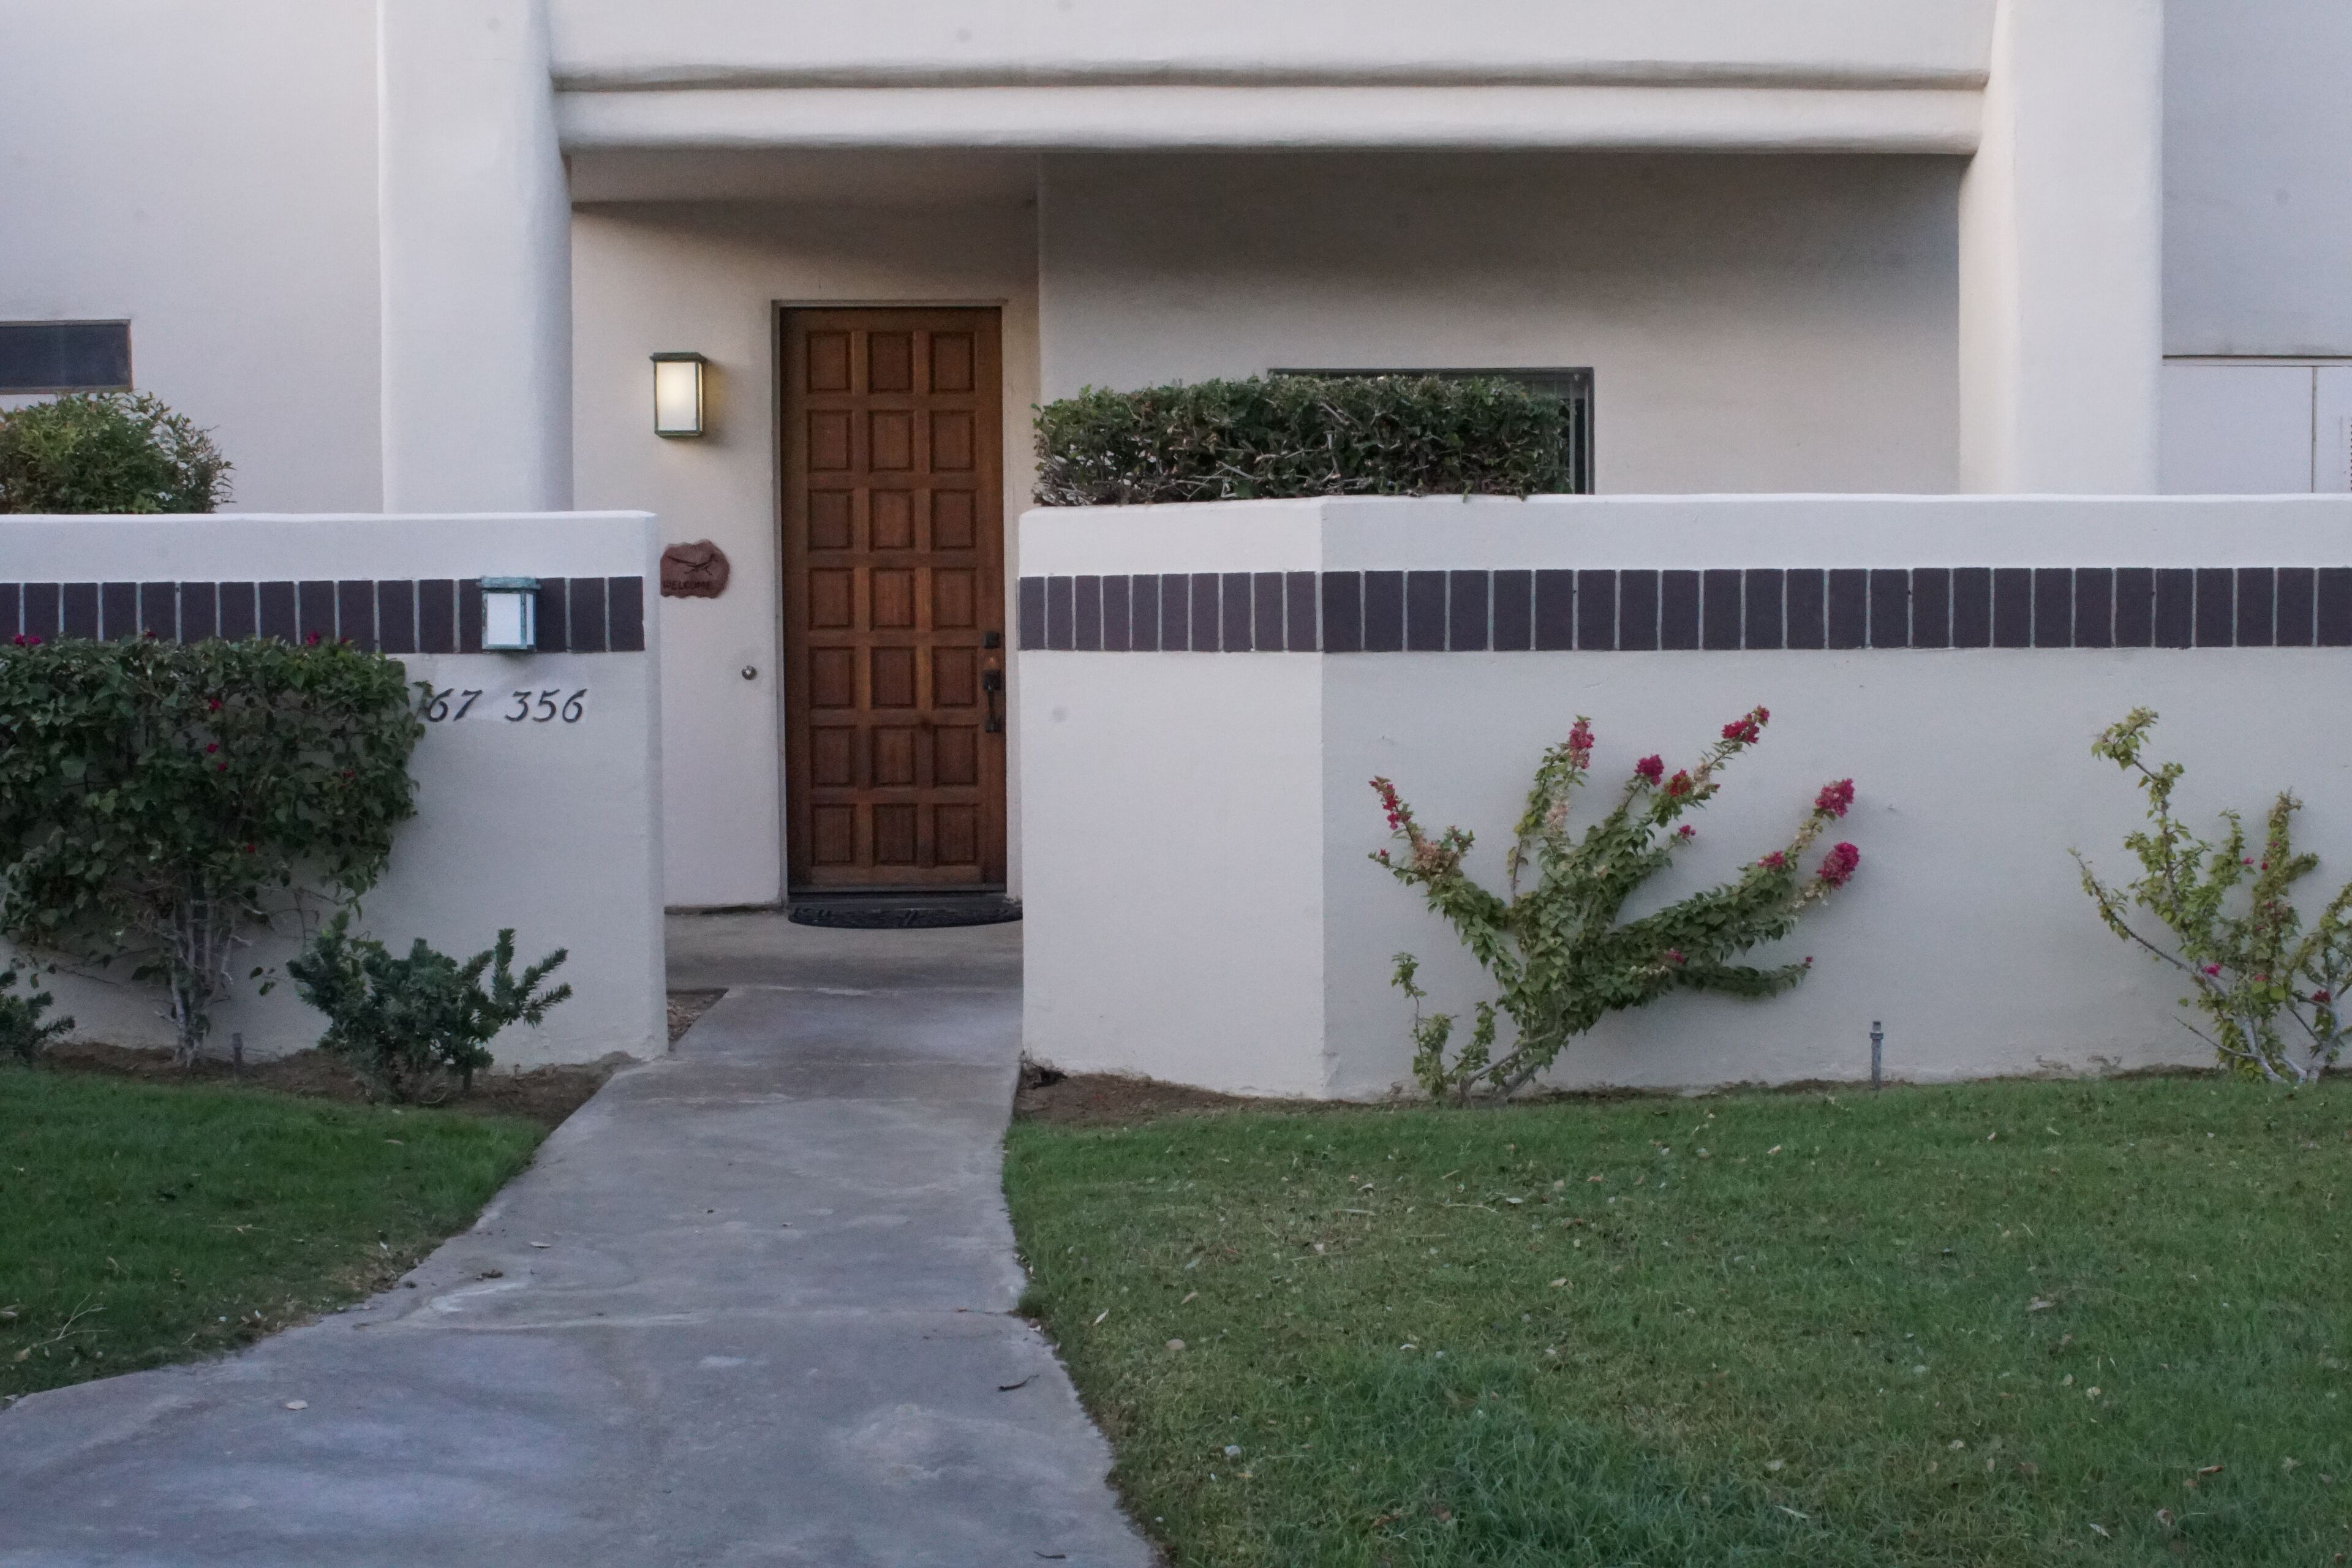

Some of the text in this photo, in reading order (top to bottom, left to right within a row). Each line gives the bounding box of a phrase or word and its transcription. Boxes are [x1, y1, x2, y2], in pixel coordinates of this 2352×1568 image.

[663, 579, 712, 590] WELCOME
[426, 688, 588, 723] 67 356
